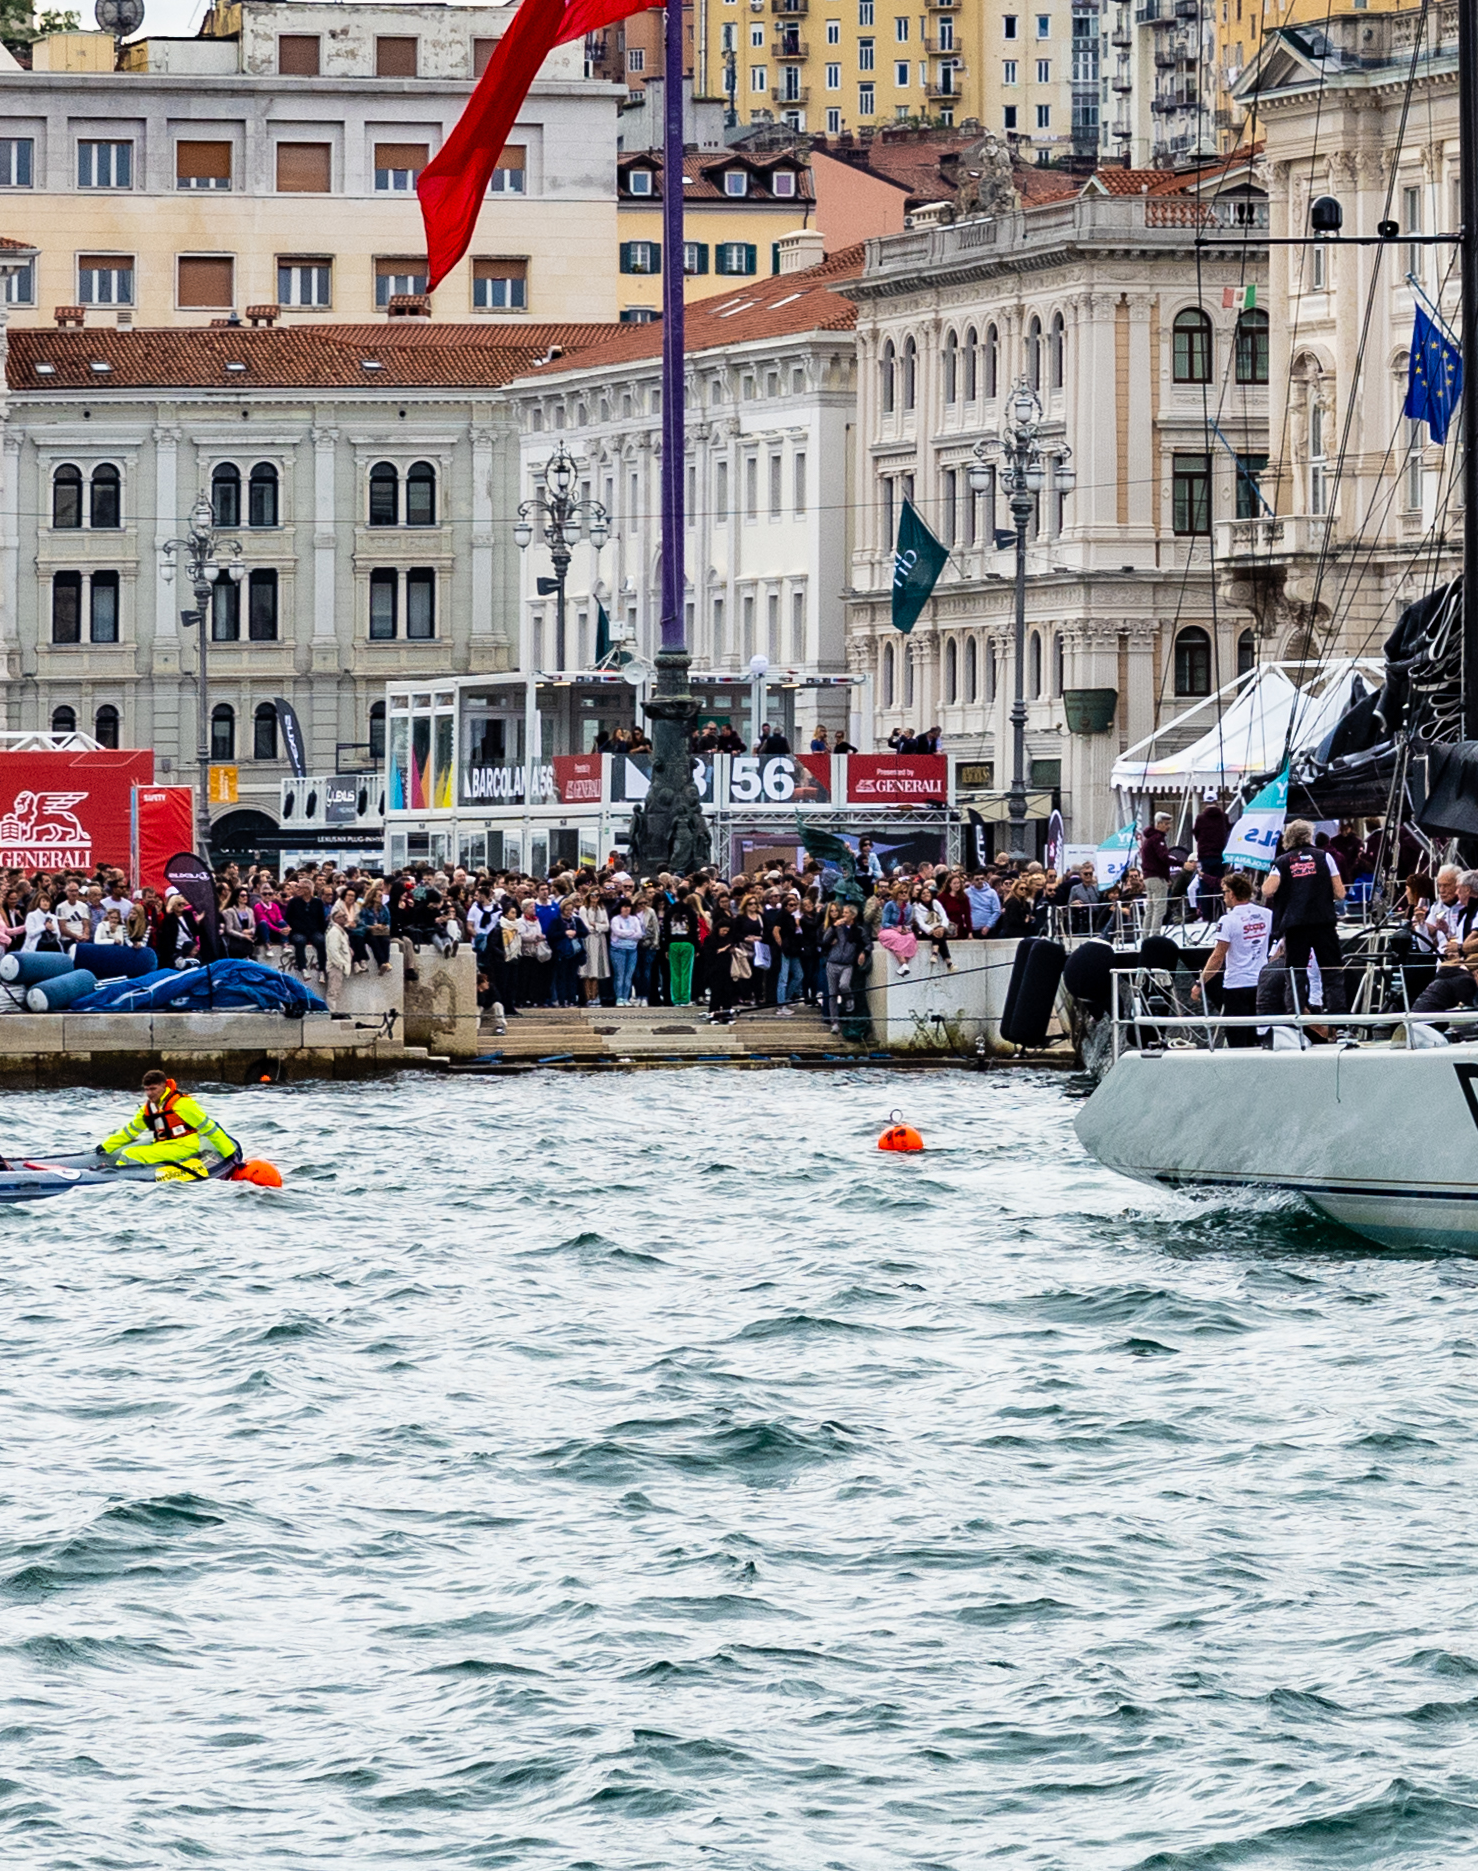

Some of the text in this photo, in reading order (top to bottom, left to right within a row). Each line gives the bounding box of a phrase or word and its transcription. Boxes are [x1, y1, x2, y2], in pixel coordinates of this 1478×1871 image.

[730, 757, 795, 801] 56
[876, 767, 915, 778] Presented by
[876, 779, 942, 794] GENERALI
